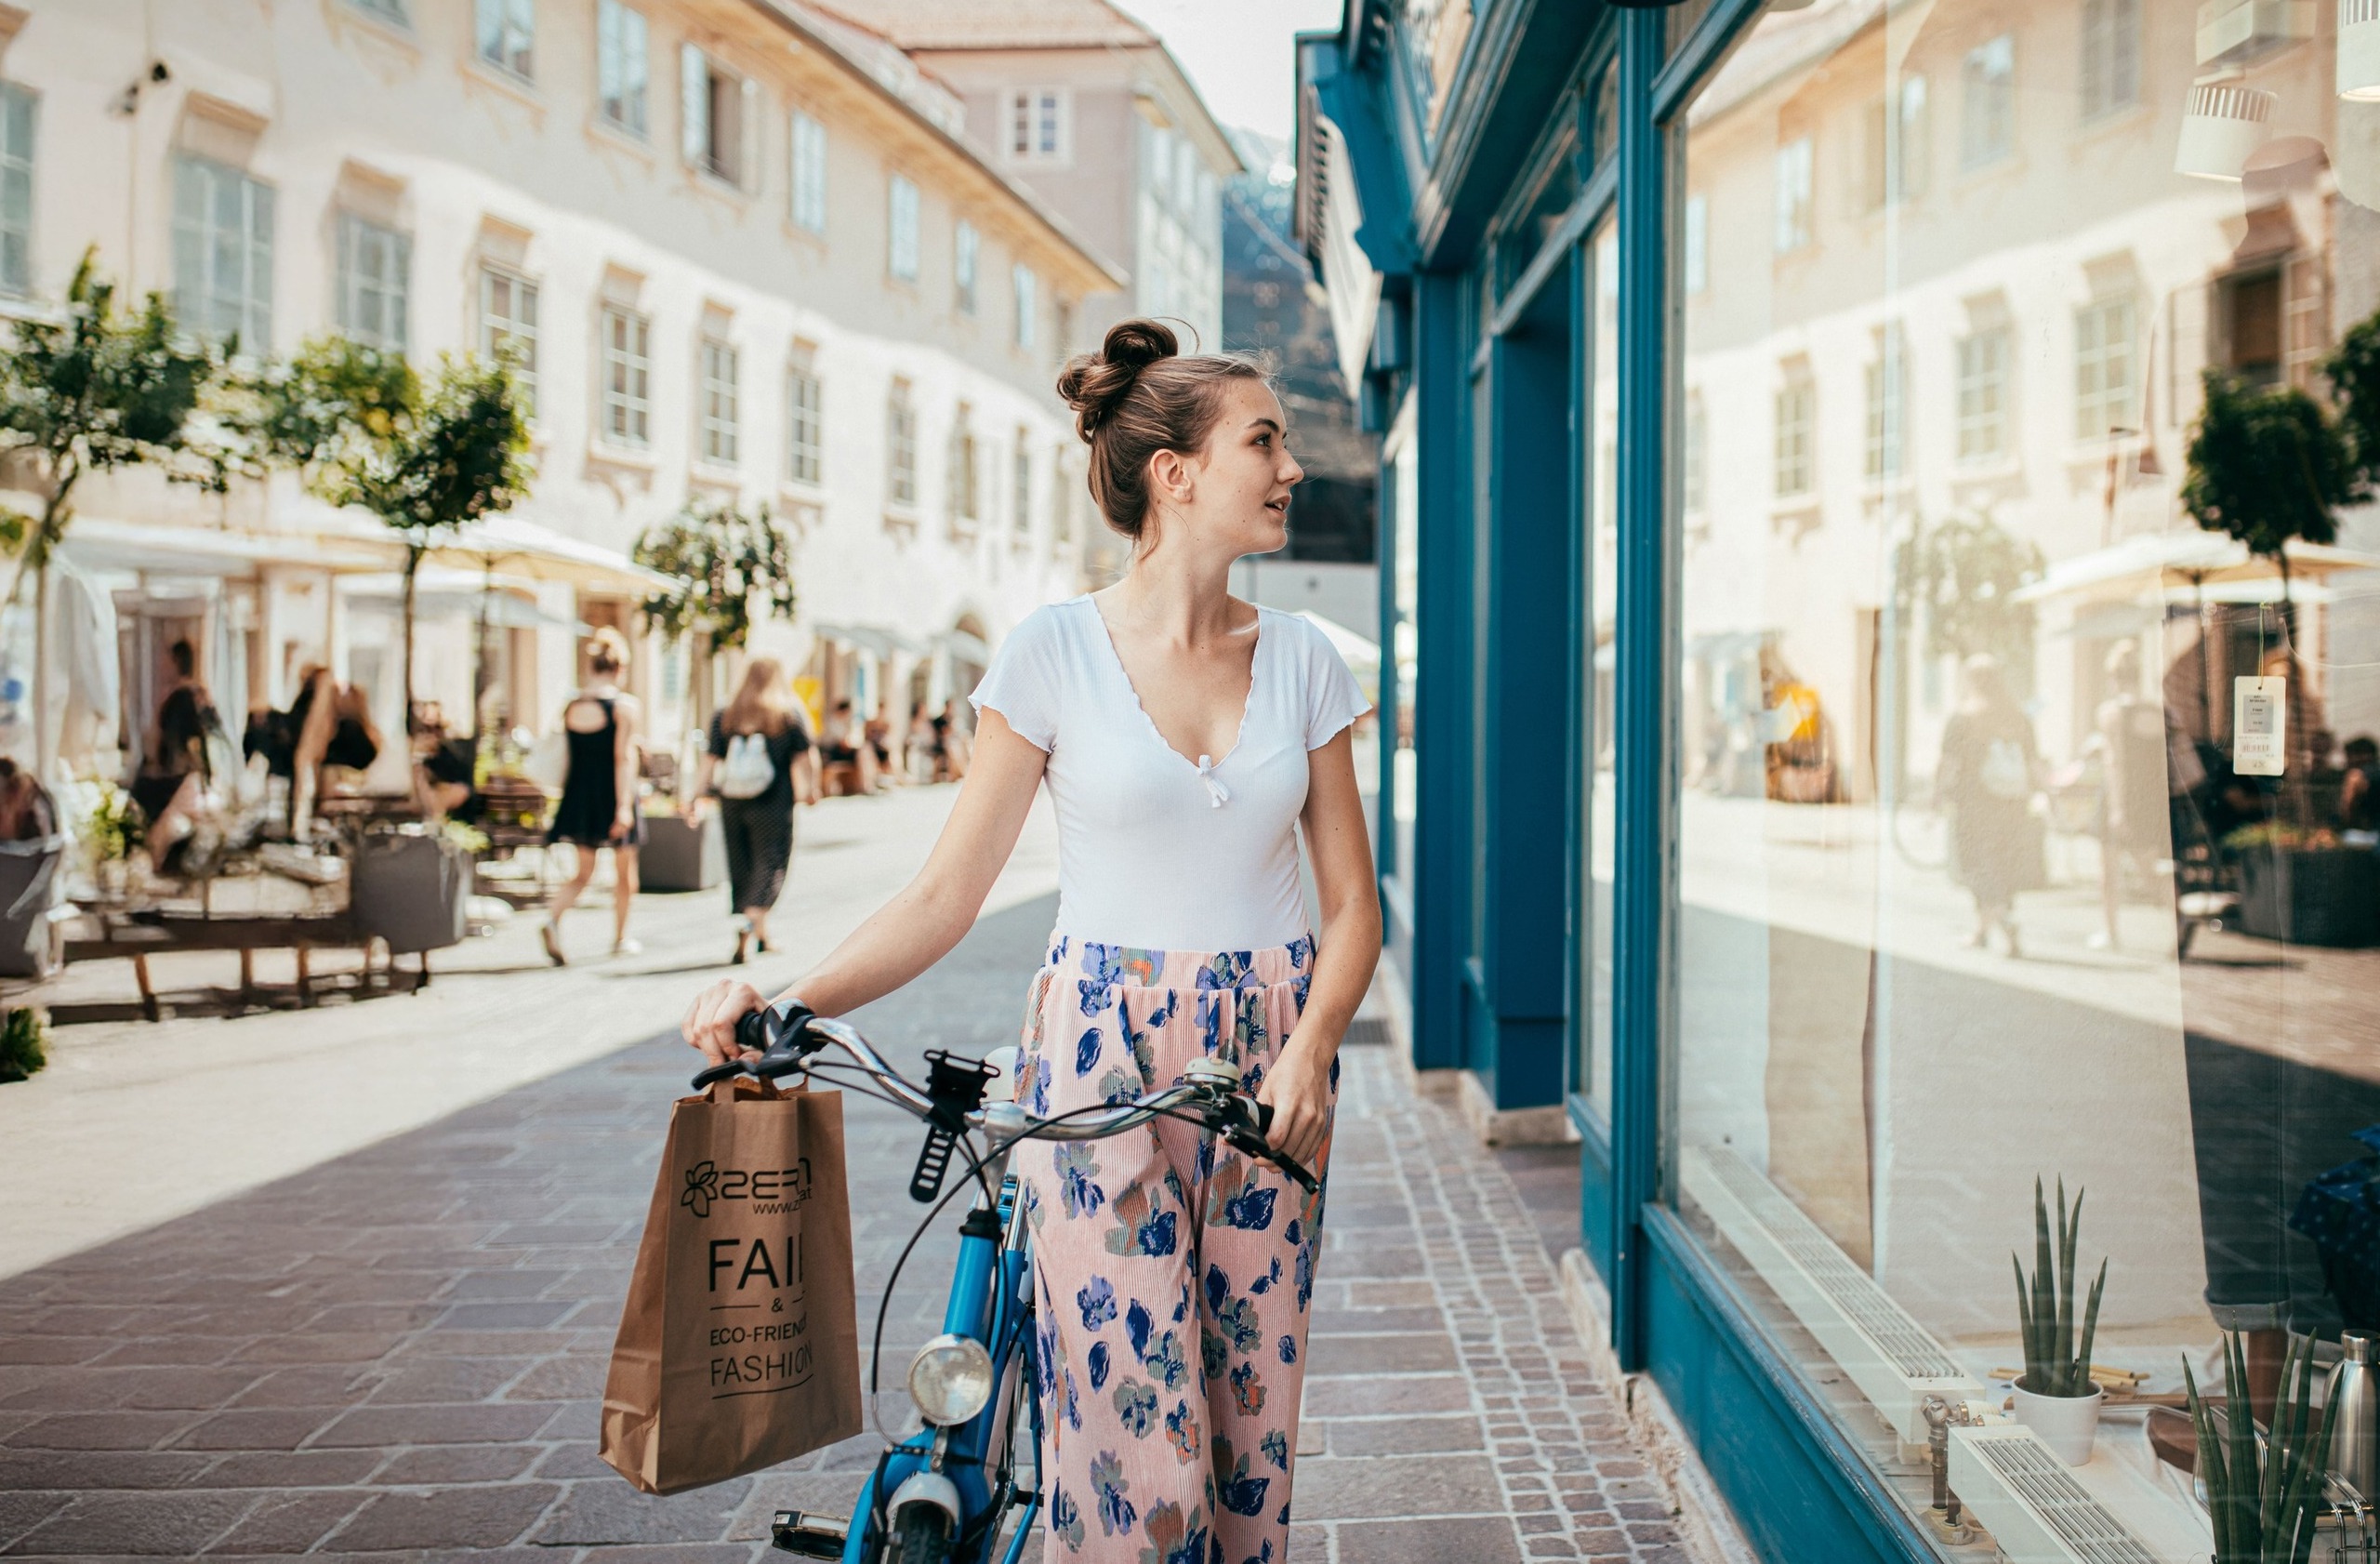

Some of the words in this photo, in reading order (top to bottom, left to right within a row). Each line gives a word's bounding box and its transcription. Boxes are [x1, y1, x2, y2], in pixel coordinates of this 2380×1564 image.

[709, 1232, 802, 1292] FAI
[771, 1297, 783, 1312] &
[710, 1339, 813, 1386] FASHION
